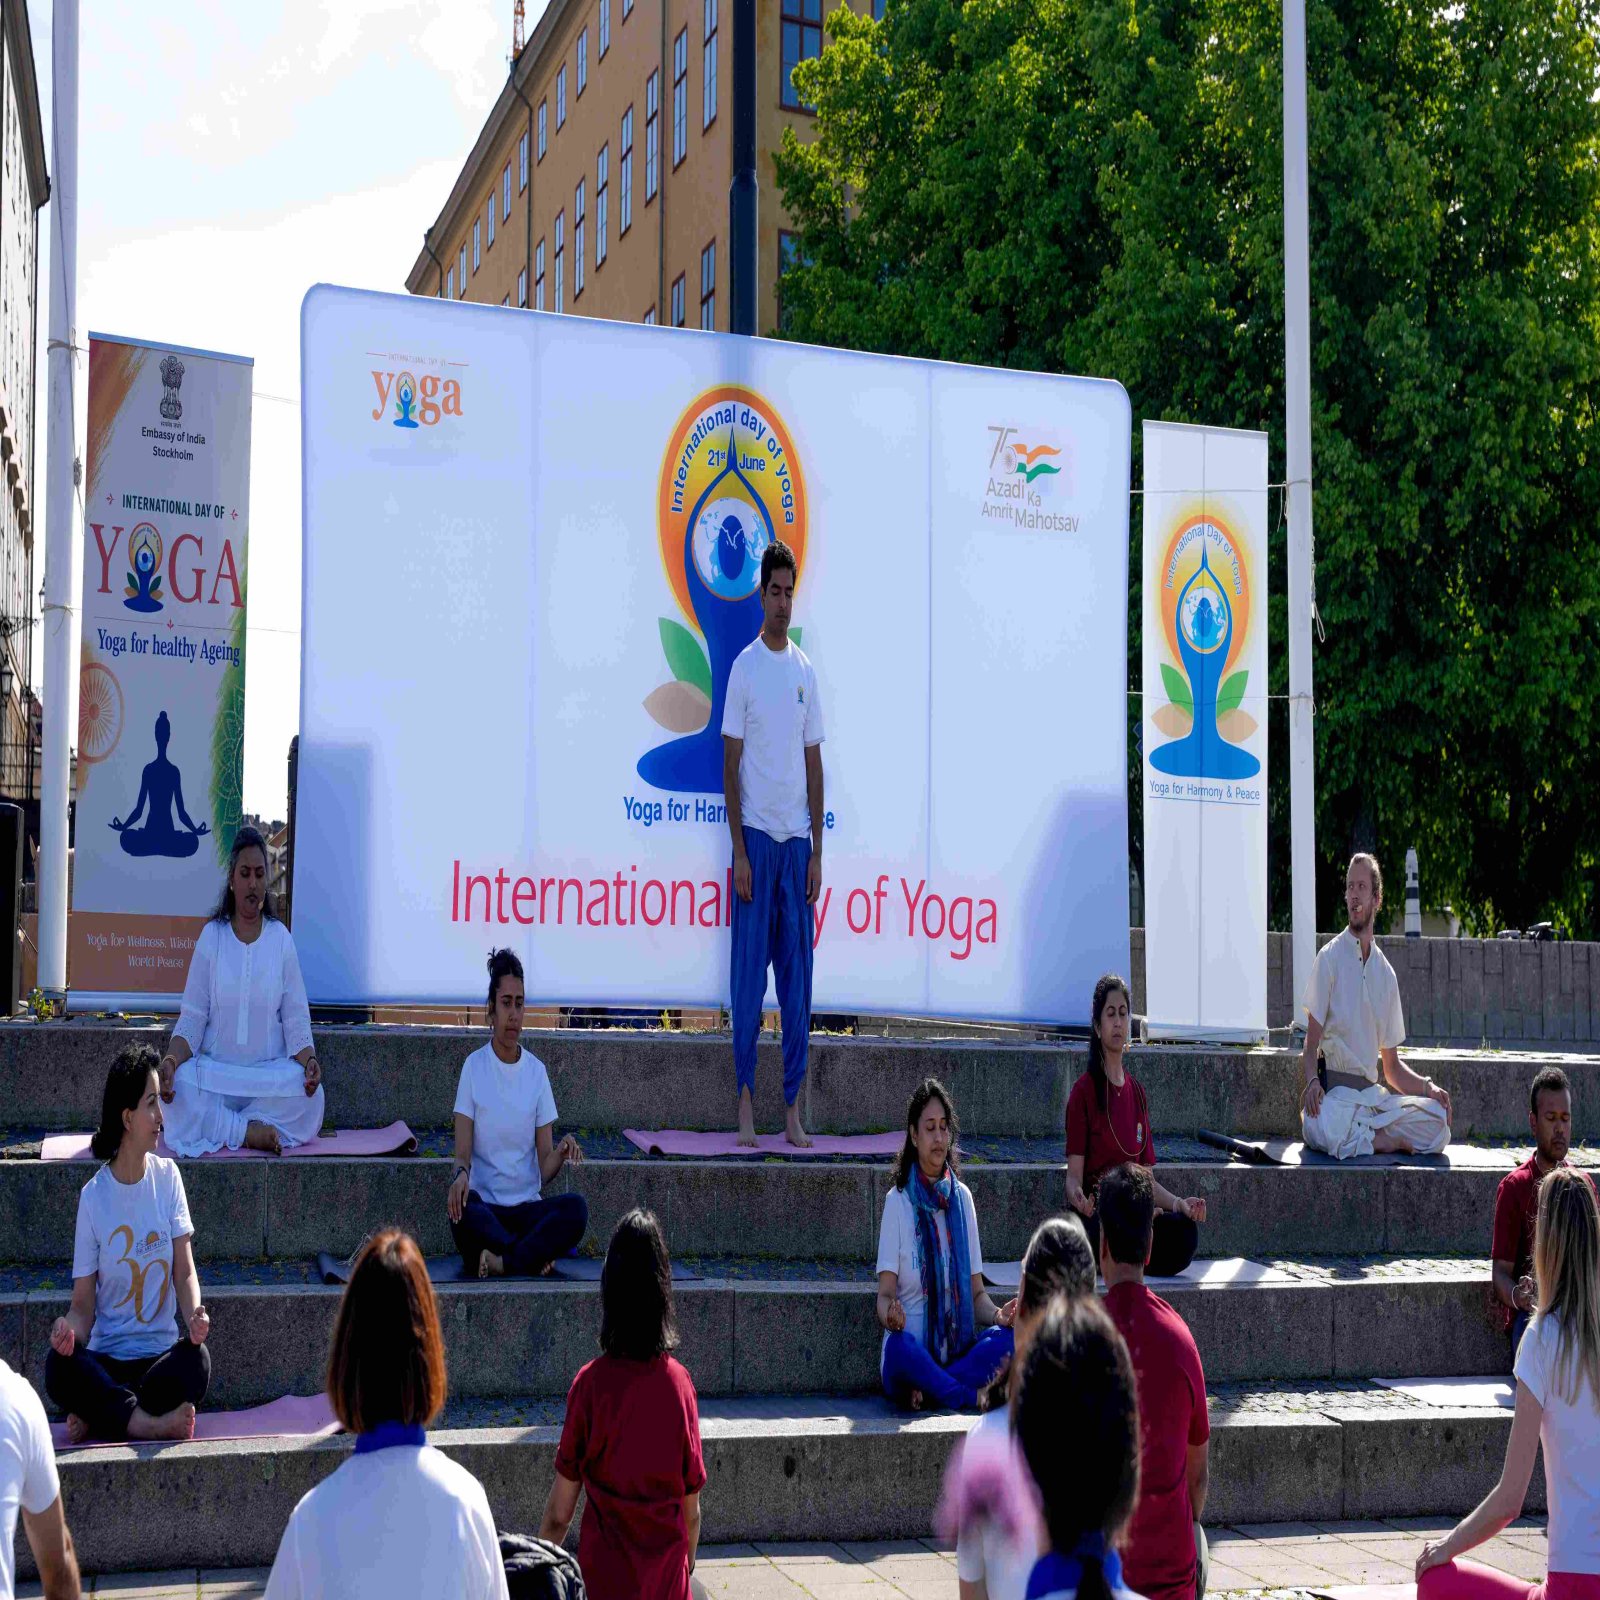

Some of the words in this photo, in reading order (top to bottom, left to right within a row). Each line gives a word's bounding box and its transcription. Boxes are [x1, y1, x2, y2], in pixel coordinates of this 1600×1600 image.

[141, 426, 175, 443] Embassy
[176, 431, 185, 442] of
[186, 433, 206, 445] India
[152, 445, 194, 461] Stockholm
[671, 404, 736, 513] International
[740, 408, 767, 441] day
[767, 437, 783, 460] of
[775, 463, 795, 524] yoga
[707, 449, 727, 467] 21st
[739, 453, 766, 472] June
[122, 494, 192, 516] INTERNATIONAL
[194, 504, 212, 518] DAY
[213, 506, 225, 519] OF
[986, 477, 1025, 499] Azadi
[1027, 491, 1042, 507] Ka
[981, 501, 1013, 519] Amrit
[1014, 508, 1080, 533] Mahotsav
[1165, 525, 1204, 588] International
[1206, 525, 1224, 546] Day
[1223, 543, 1233, 556] of
[97, 628, 127, 657] Yoga
[130, 631, 149, 654] for
[152, 634, 197, 664] healthy
[199, 638, 240, 667] Ageing
[1149, 780, 1170, 796] Yoga
[1172, 782, 1184, 795] for
[1187, 784, 1223, 800] Harmony
[1226, 785, 1233, 798] &
[1235, 786, 1260, 800] Peace
[623, 796, 663, 827] Yoga
[667, 798, 690, 822] for
[451, 860, 732, 928] International
[846, 875, 889, 935] of
[900, 877, 998, 961] Yoga
[87, 933, 108, 952] Yoga
[169, 937, 198, 950] Wisdo
[108, 1224, 169, 1324] 30
